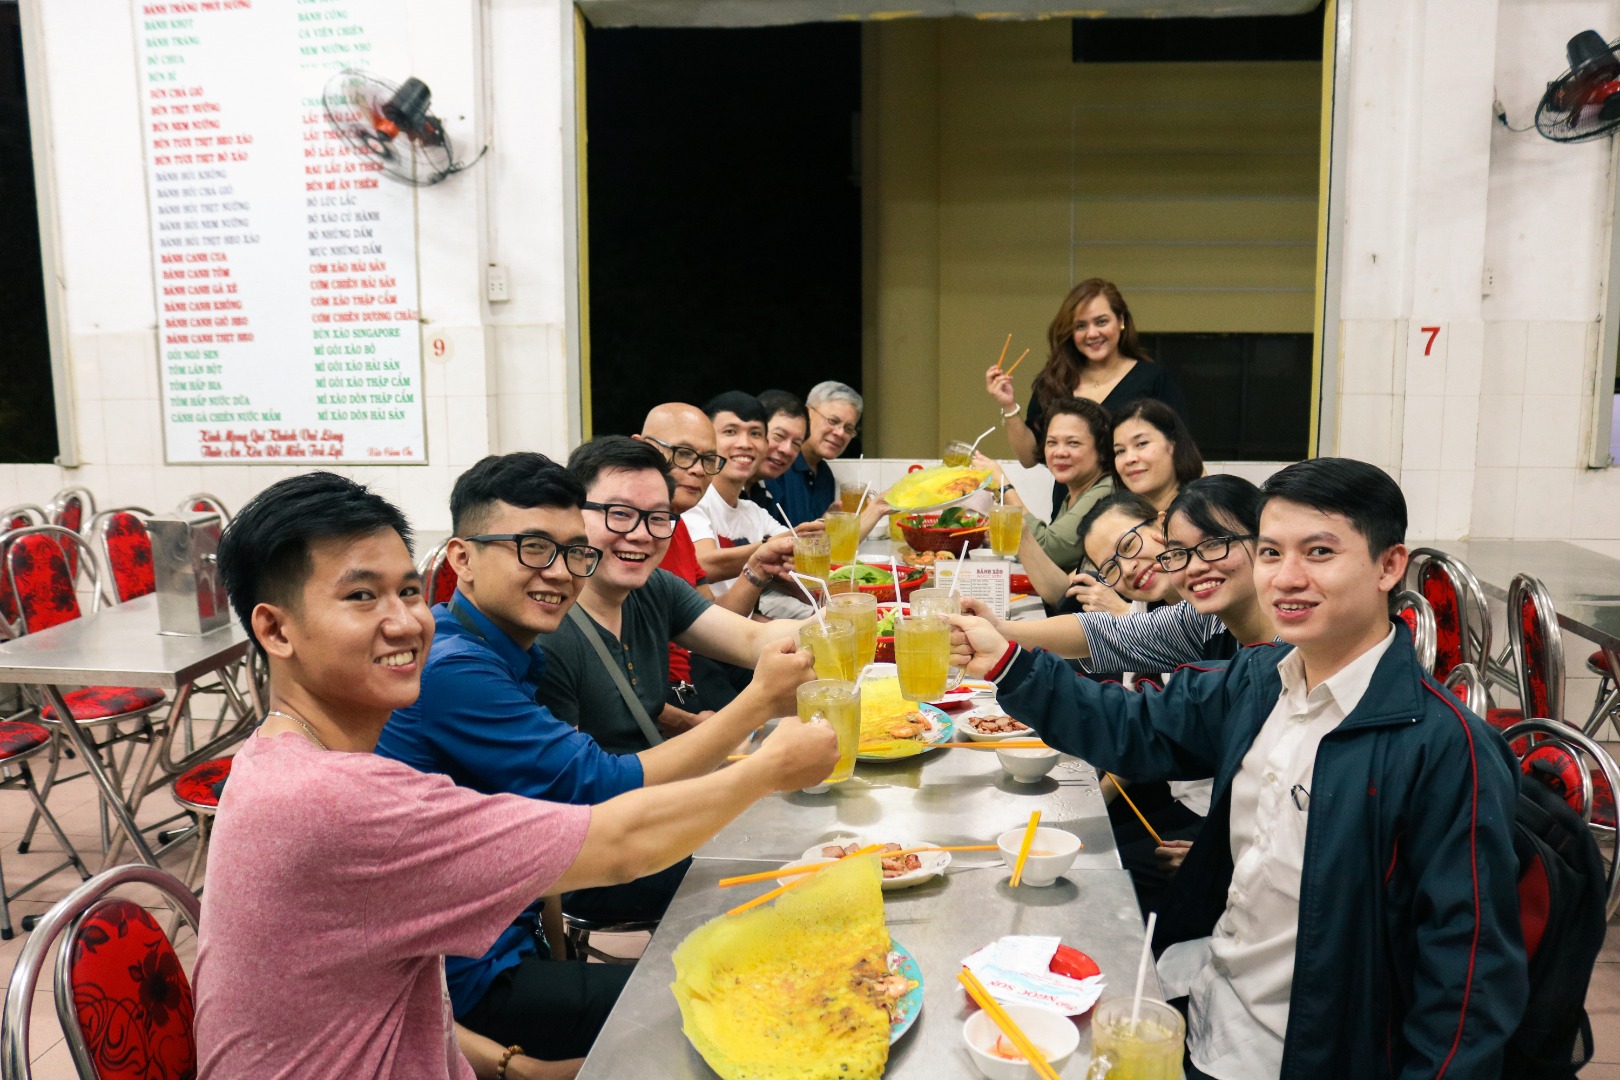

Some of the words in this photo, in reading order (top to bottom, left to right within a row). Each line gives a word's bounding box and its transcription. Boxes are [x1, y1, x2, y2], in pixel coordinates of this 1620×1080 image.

[353, 328, 400, 338] SINGAPORE
[1421, 327, 1440, 356] 7
[434, 338, 445, 356] 9
